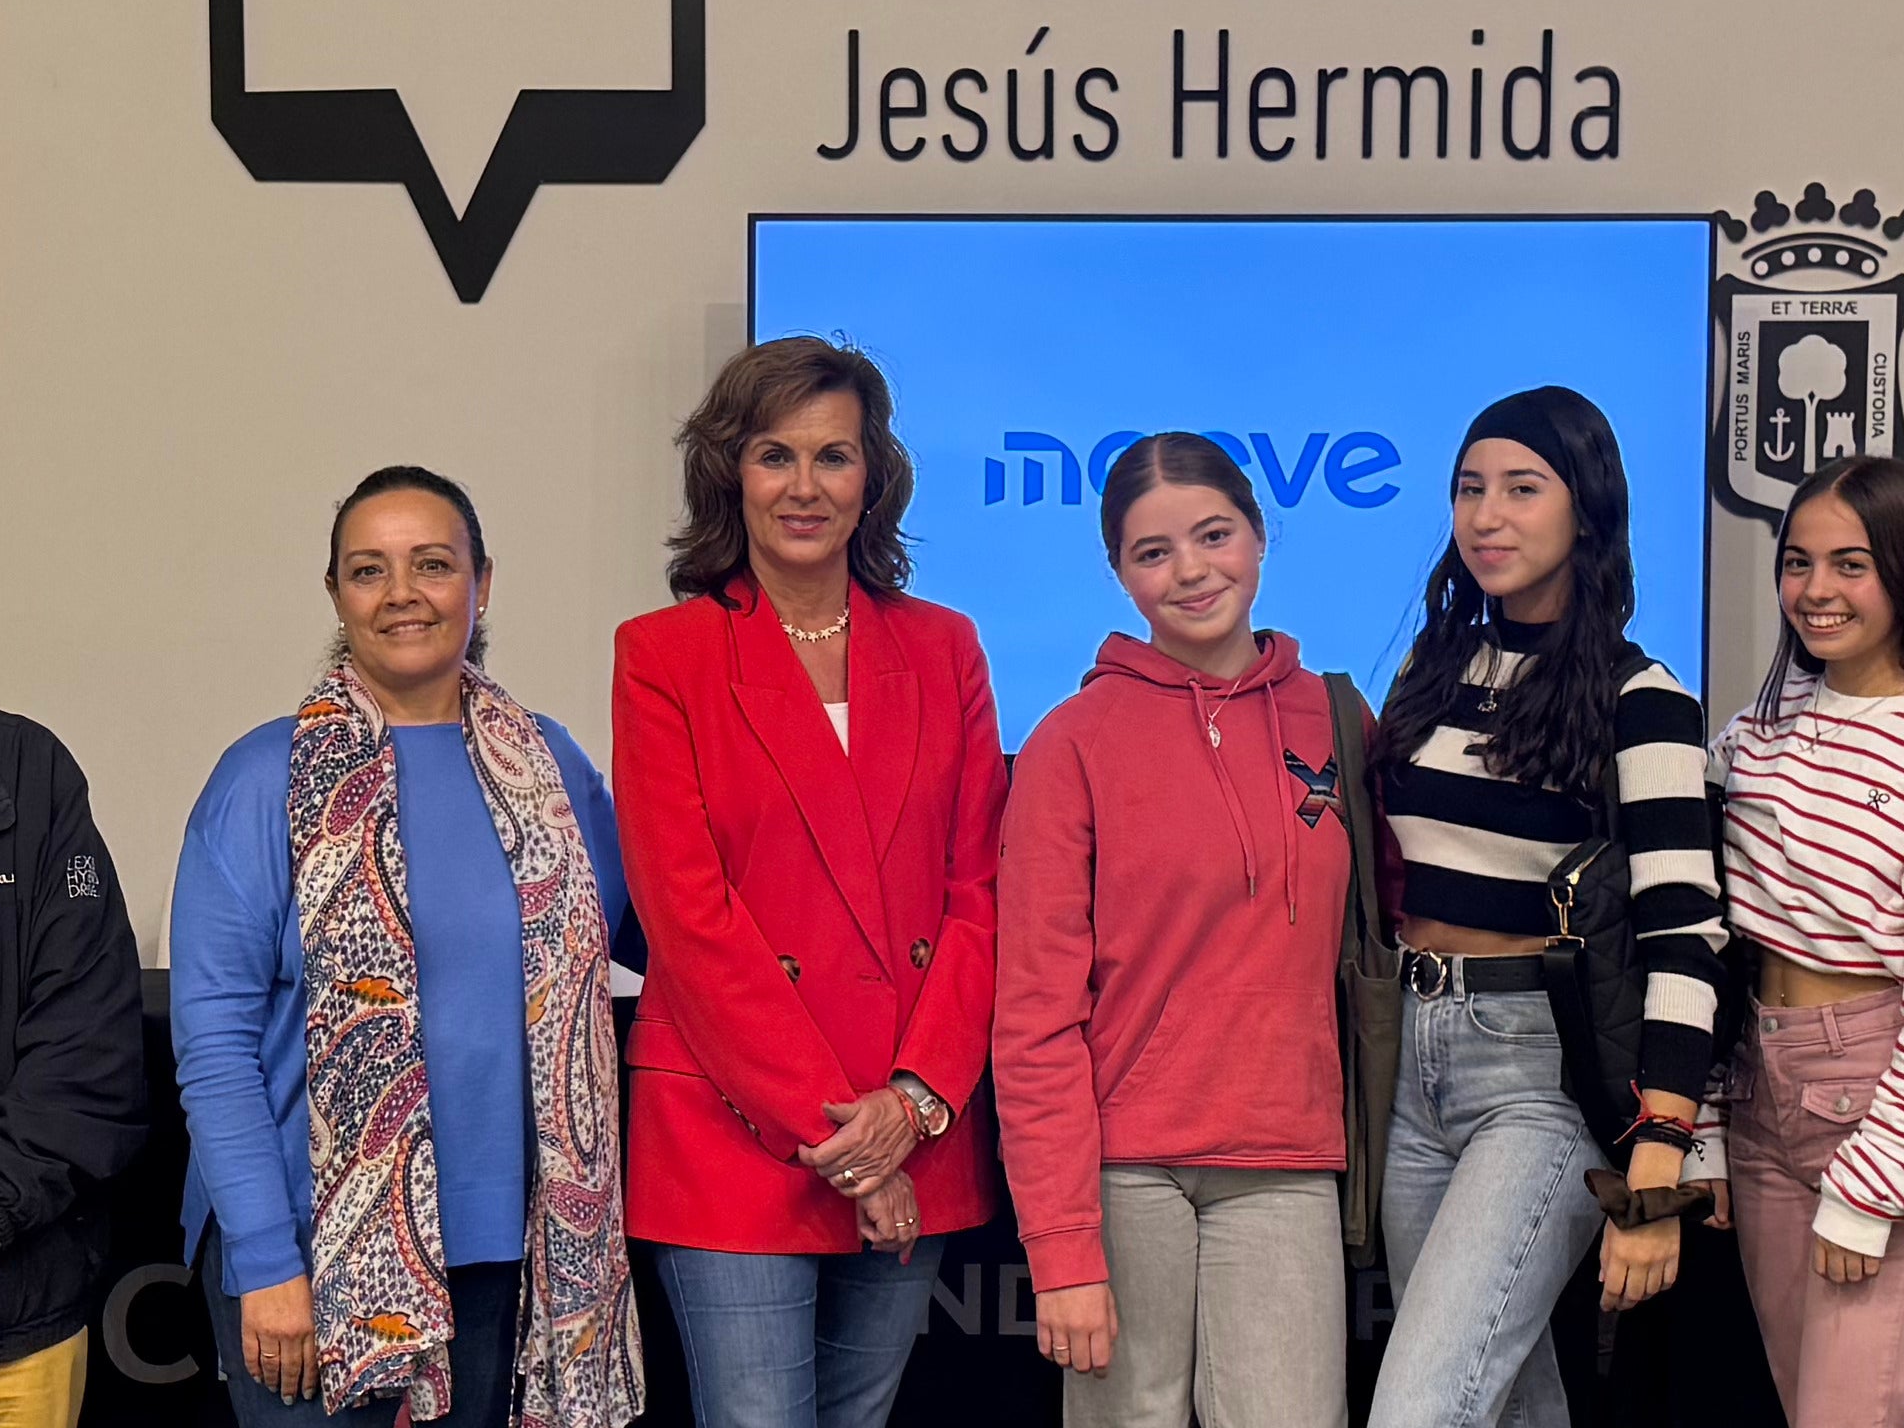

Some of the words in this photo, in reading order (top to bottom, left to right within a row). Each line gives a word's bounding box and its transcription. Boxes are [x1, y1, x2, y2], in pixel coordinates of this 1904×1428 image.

[815, 25, 1121, 162] Jesús
[1171, 27, 1622, 162] Hermida
[1770, 300, 1793, 316] ET
[1736, 330, 1751, 386] MARIS
[1734, 393, 1750, 462] PORTUS
[1870, 352, 1888, 439] CUSTODIA
